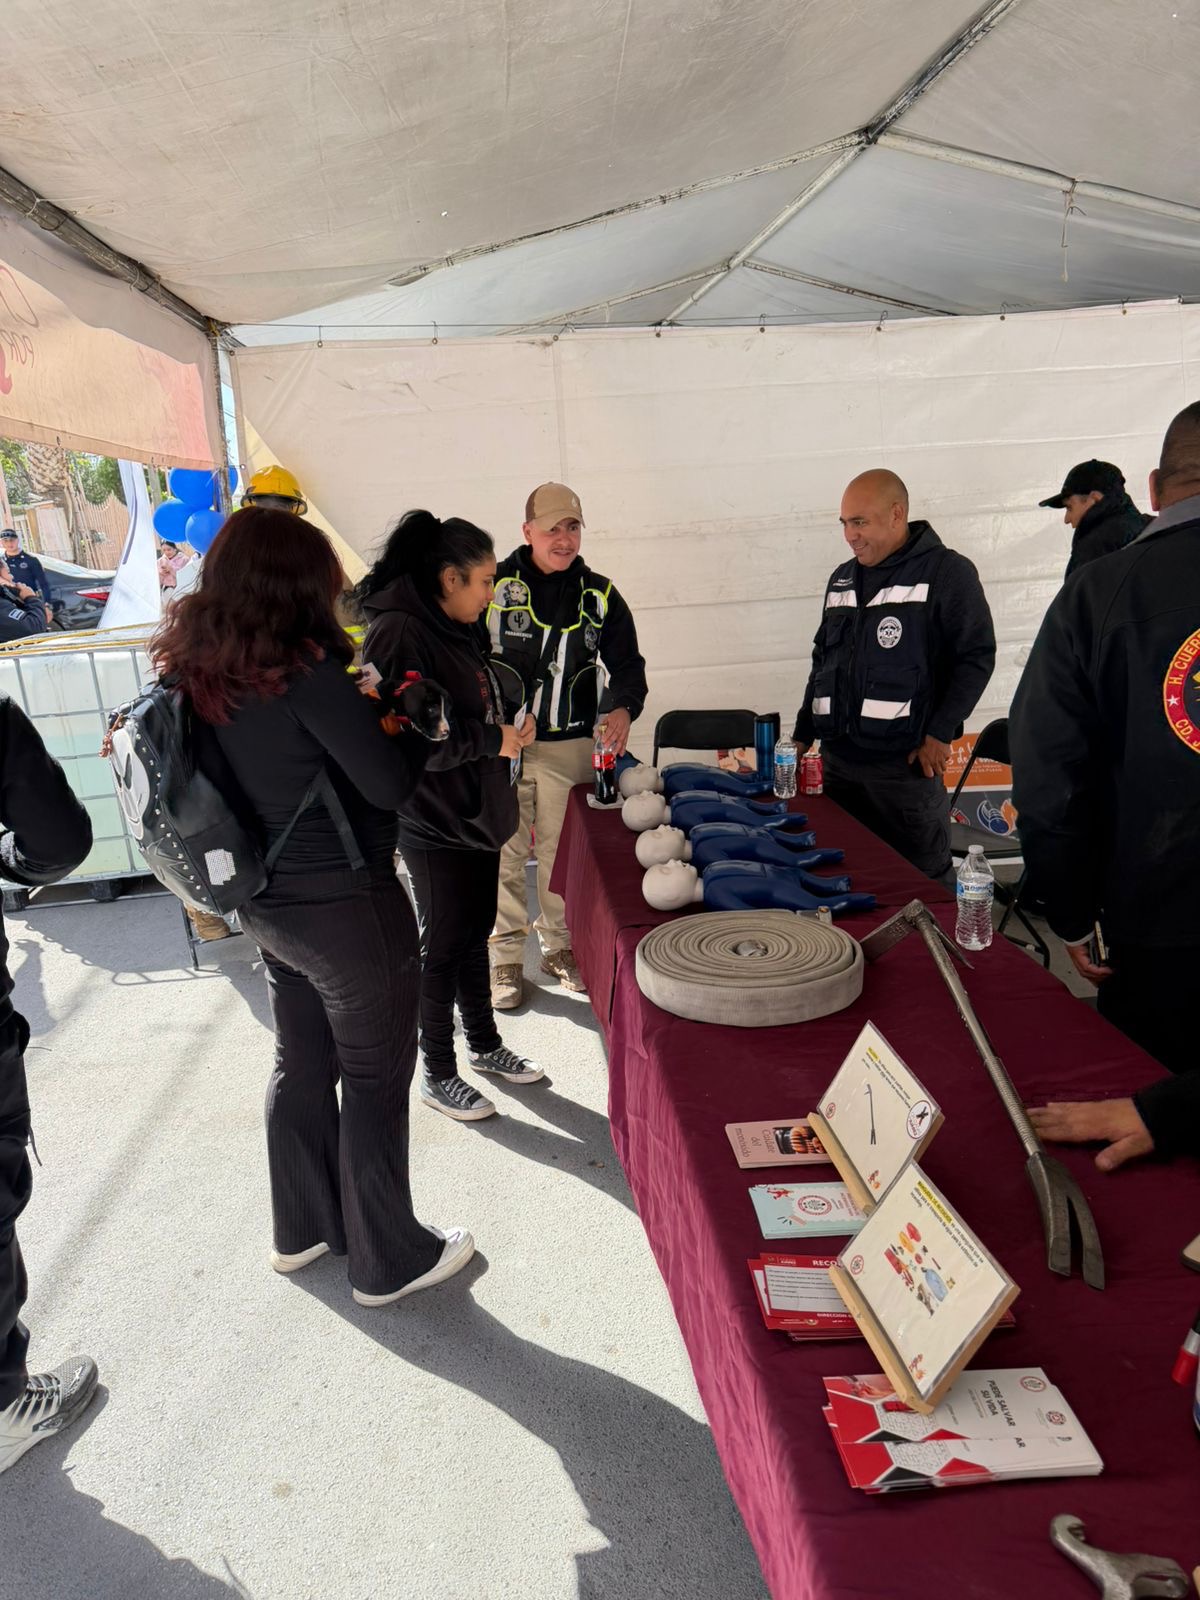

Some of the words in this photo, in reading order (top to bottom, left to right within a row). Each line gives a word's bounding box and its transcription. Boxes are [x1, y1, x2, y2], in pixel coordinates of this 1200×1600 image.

[1174, 634, 1200, 669] CUER
[1168, 674, 1184, 685] H.
[1175, 718, 1193, 740] CD.
[980, 1390, 991, 1398] SU
[986, 1400, 998, 1416] VIDA
[987, 1380, 1004, 1398] PUEDE
[997, 1400, 1016, 1426] SALVAR
